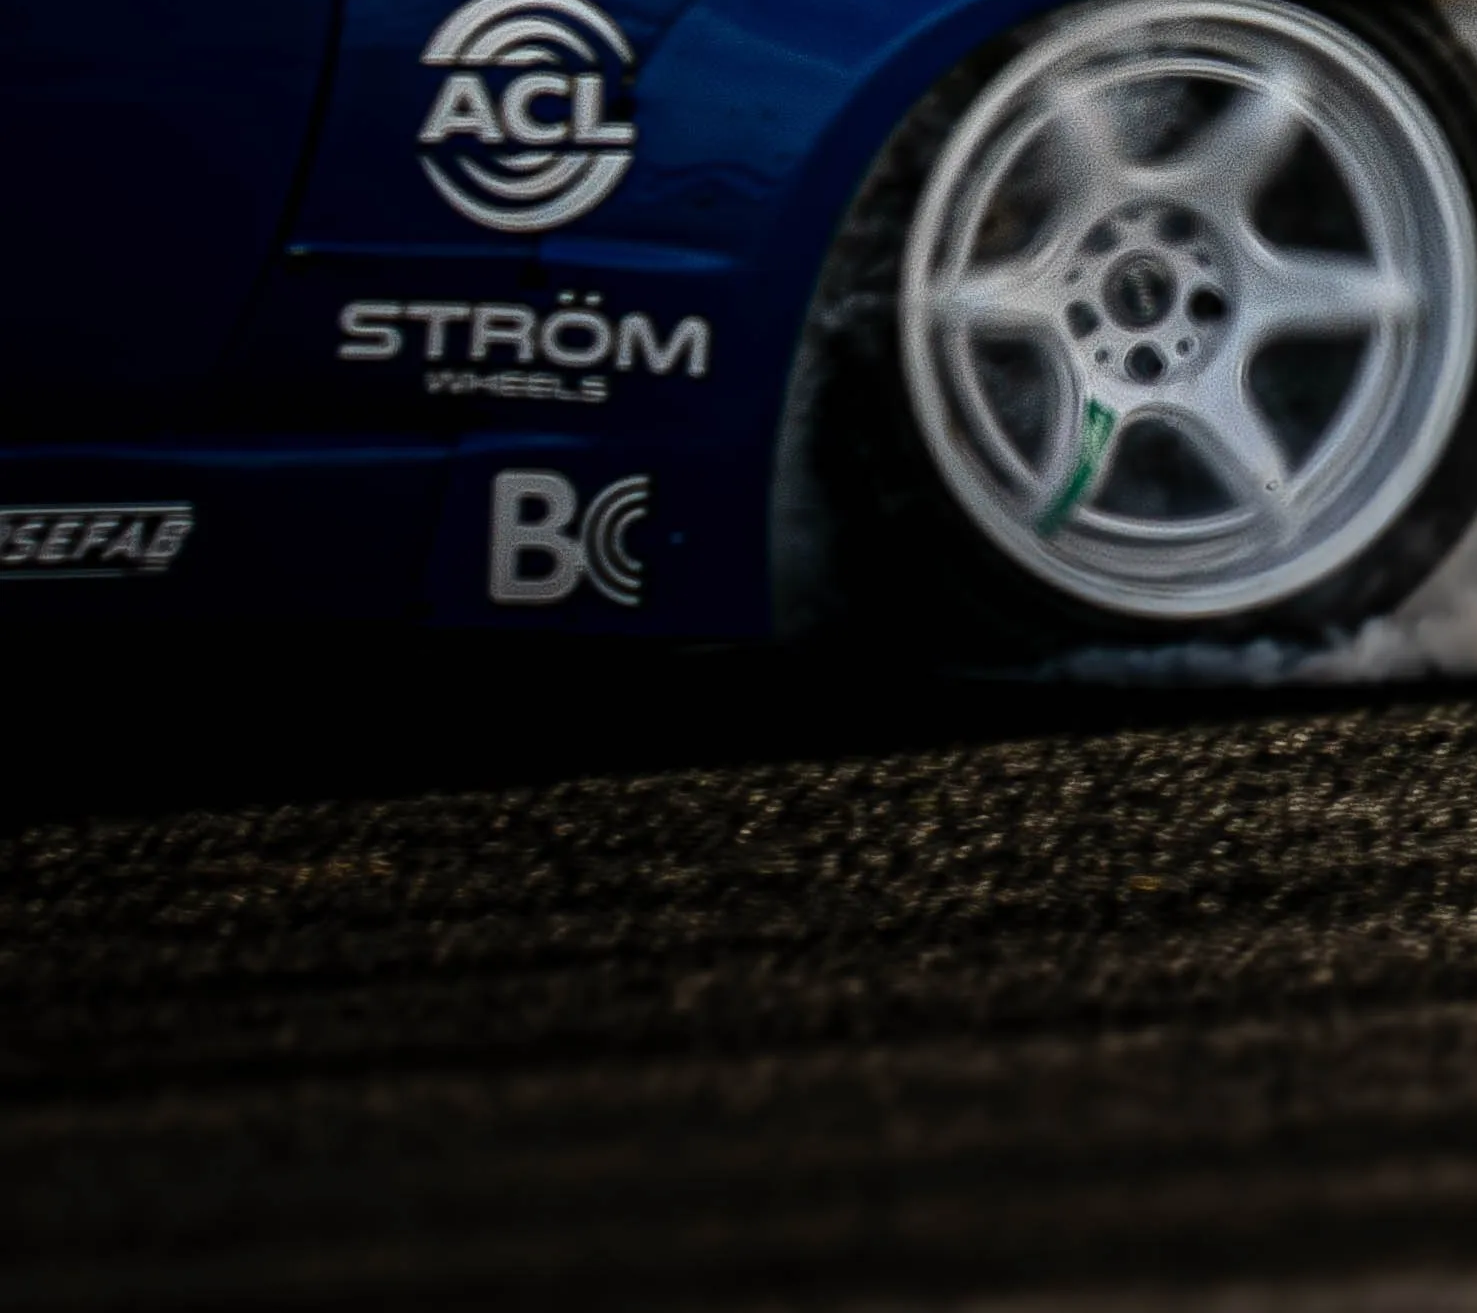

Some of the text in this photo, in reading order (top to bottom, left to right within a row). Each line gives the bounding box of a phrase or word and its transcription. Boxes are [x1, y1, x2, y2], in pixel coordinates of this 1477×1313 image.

[418, 75, 637, 145] ACL
[337, 291, 711, 376] STRÖM
[424, 369, 610, 403] WHEELS
